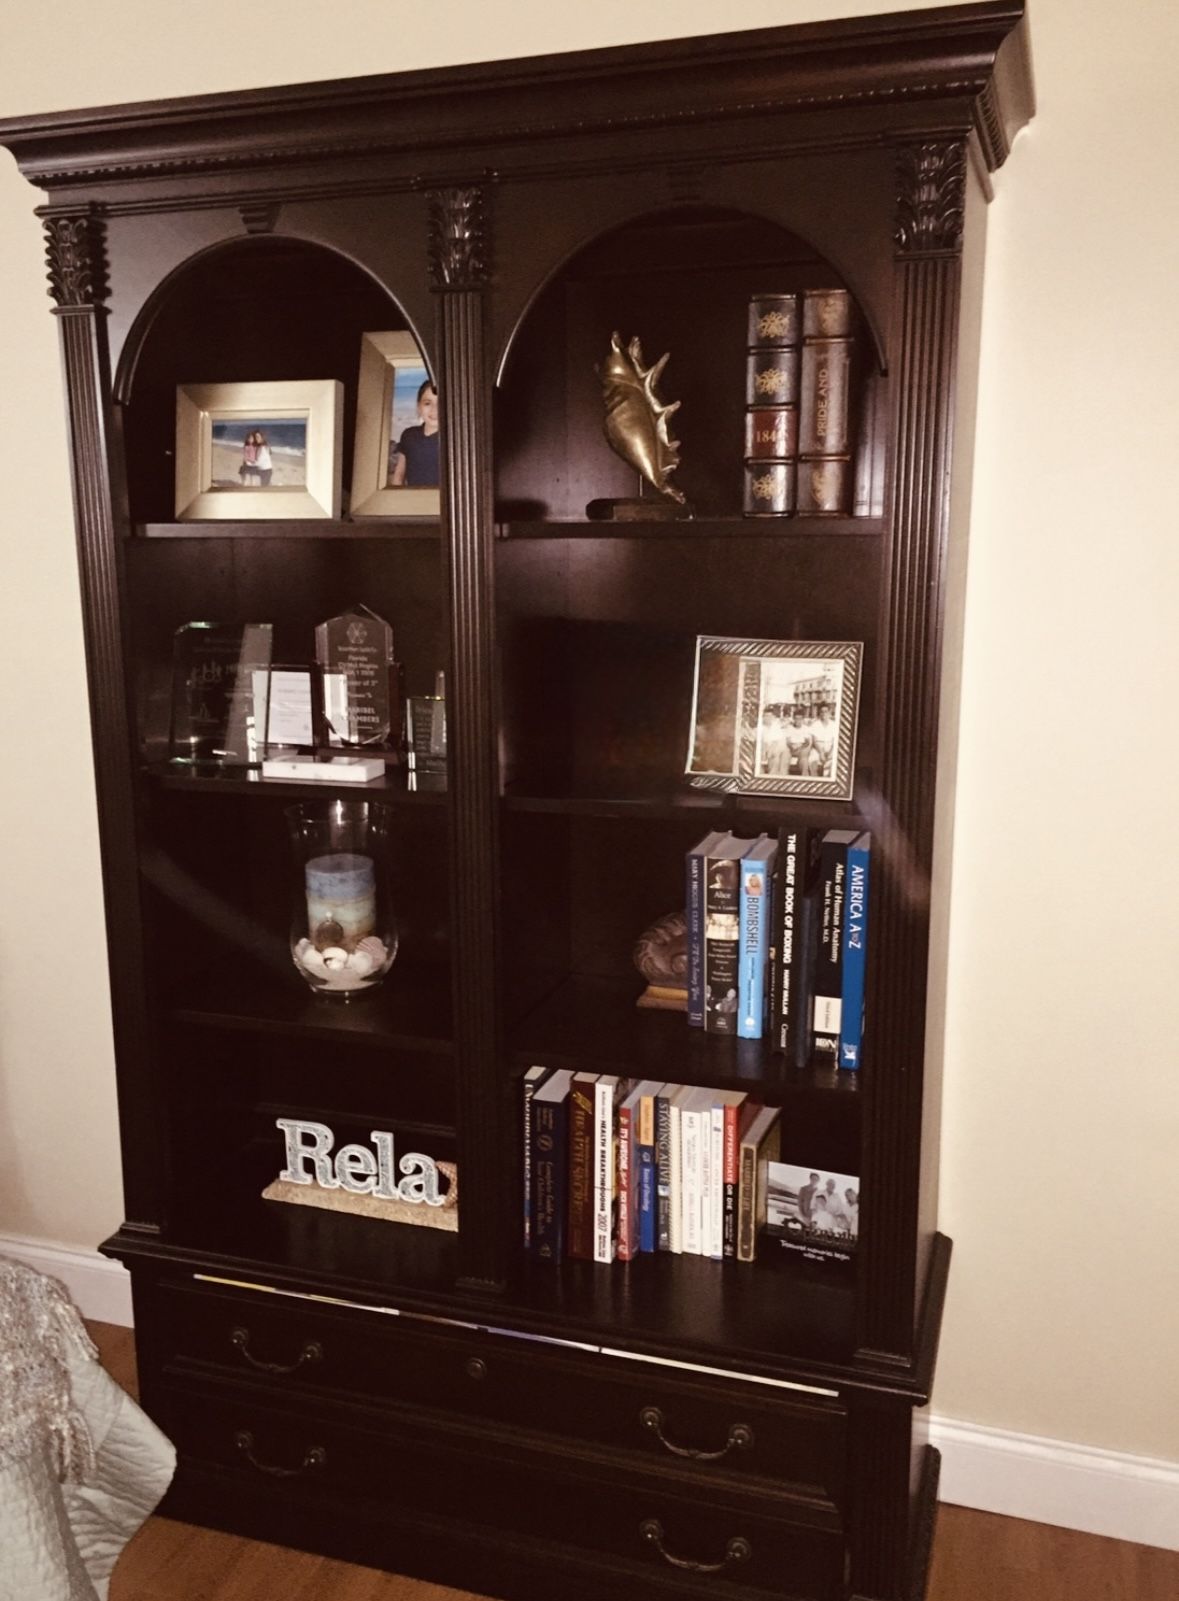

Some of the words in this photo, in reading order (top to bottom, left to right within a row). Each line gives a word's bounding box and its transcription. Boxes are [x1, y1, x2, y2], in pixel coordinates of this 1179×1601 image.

[818, 369, 829, 395] AND
[817, 400, 828, 436] PRIDE
[787, 834, 796, 852] THE
[786, 855, 796, 885] GREAT
[835, 863, 844, 883] Atlas
[785, 887, 794, 913] BOOK
[835, 885, 843, 894] of
[850, 865, 864, 919] AMERICA
[784, 916, 793, 928] OF
[833, 896, 842, 925] Human
[746, 897, 760, 955] BOMBSHELL
[783, 929, 793, 963] BOXING
[830, 927, 840, 963] Anatomy
[573, 1111, 585, 1163] HEALTH
[658, 1103, 668, 1150] STAYING
[276, 1117, 446, 1207] Rela
[659, 1153, 669, 1182] ALIVE
[726, 1125, 734, 1182] DIFFERENTIATE
[726, 1184, 732, 1195] OR
[597, 1214, 607, 1231] 2007
